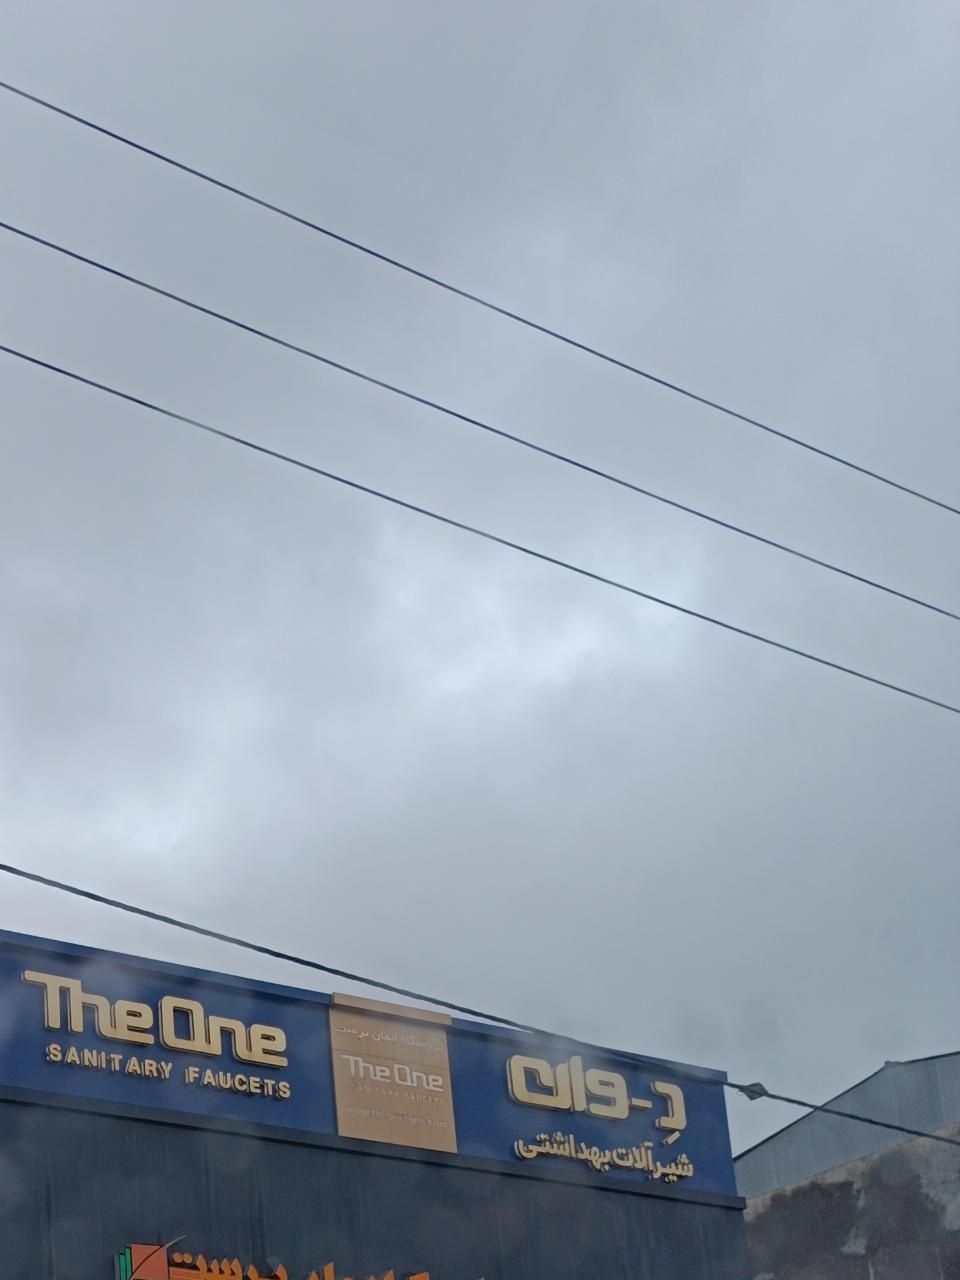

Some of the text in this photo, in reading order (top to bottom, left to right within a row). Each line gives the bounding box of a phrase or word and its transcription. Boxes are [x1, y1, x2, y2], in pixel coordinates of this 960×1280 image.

[20, 970, 289, 1068] The One
[46, 1043, 292, 1100] SANITARY FAUCETS
[341, 1054, 445, 1093] The One
[514, 1131, 611, 1171] بهداشتی
